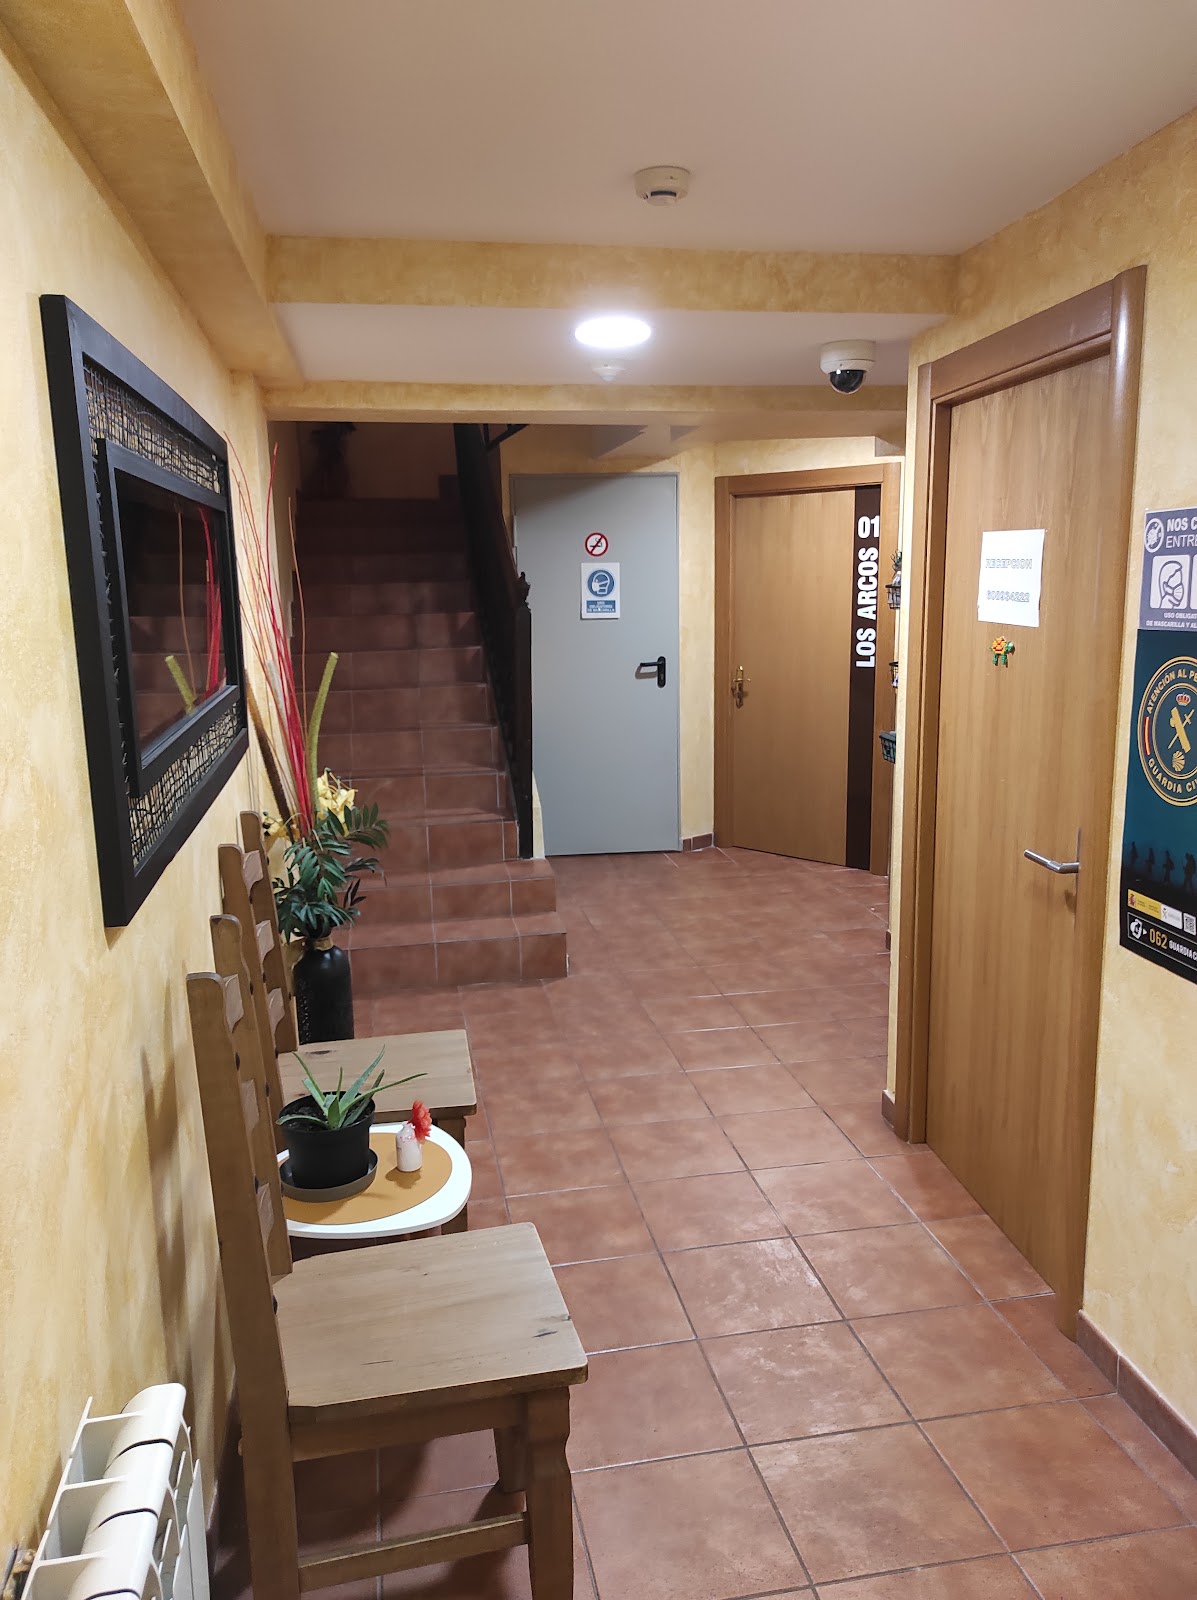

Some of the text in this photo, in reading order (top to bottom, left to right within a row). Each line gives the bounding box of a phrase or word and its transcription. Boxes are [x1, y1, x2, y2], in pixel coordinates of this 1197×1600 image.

[1166, 517, 1188, 532] NOS
[855, 515, 880, 668] LOS ARCOS 01
[1153, 620, 1185, 628] MASCARILLA
[1146, 670, 1175, 714] ATENCIÓN
[1177, 668, 1187, 679] AL
[1148, 757, 1183, 794] GUARDIA
[1149, 928, 1168, 950] 062
[1169, 940, 1192, 958] GUARDIA
